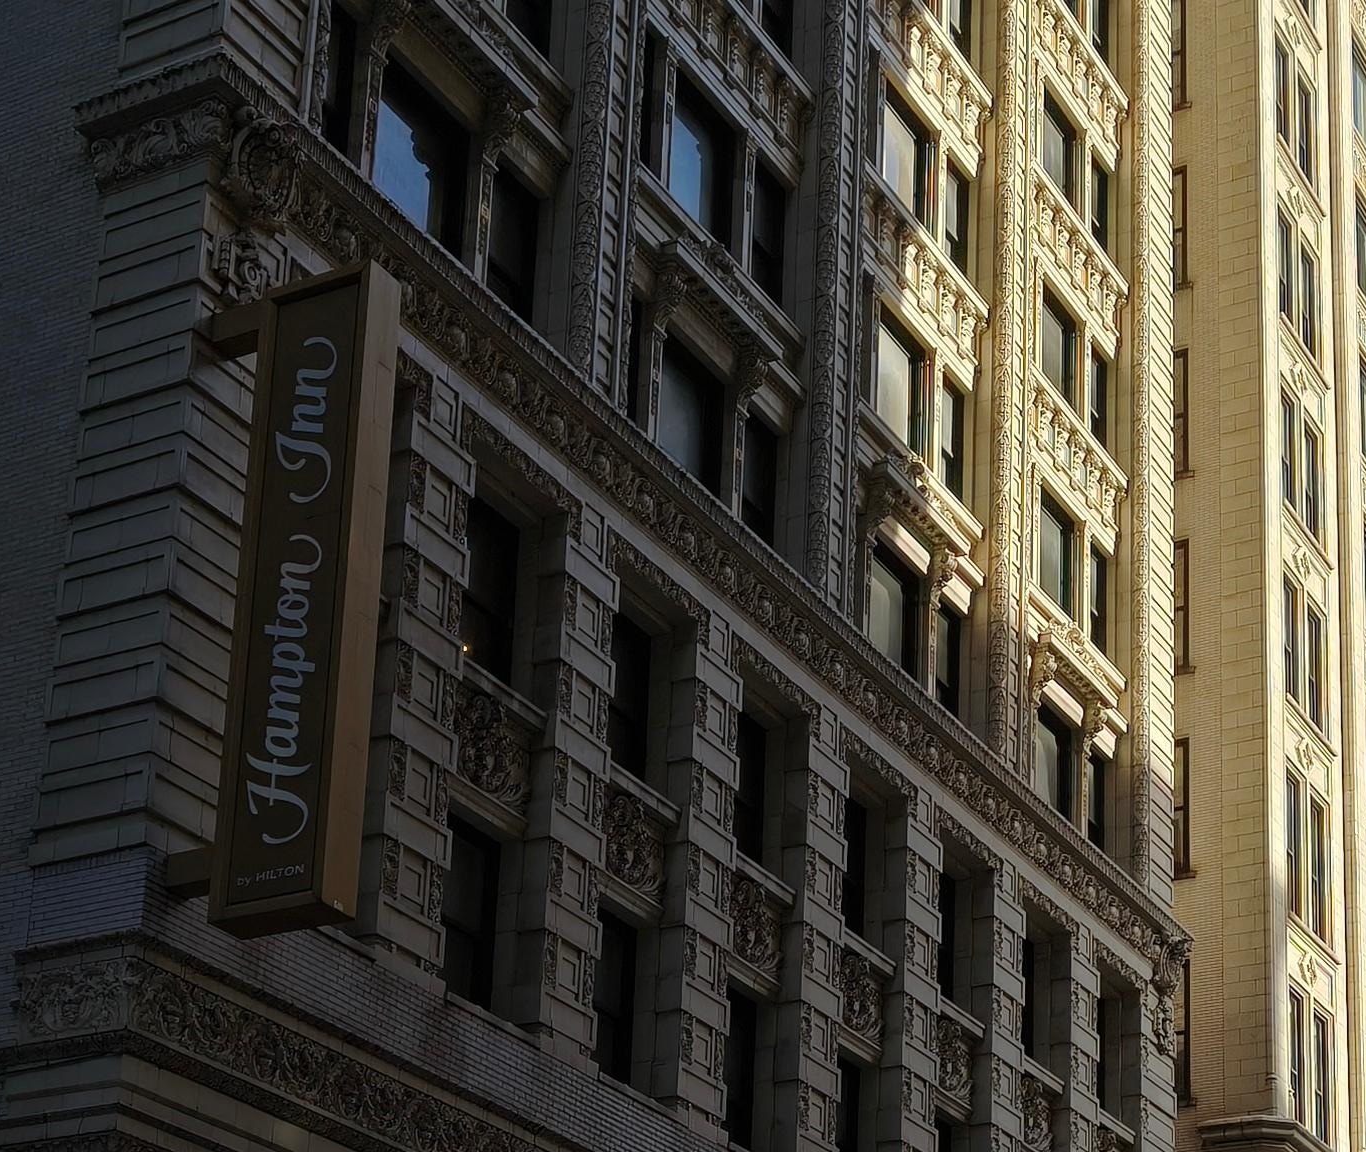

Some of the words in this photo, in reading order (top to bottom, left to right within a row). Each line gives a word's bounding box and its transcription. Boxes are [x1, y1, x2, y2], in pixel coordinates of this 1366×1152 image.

[275, 336, 338, 504] Inn
[246, 534, 323, 846] Hampton
[256, 863, 305, 882] HILTON
